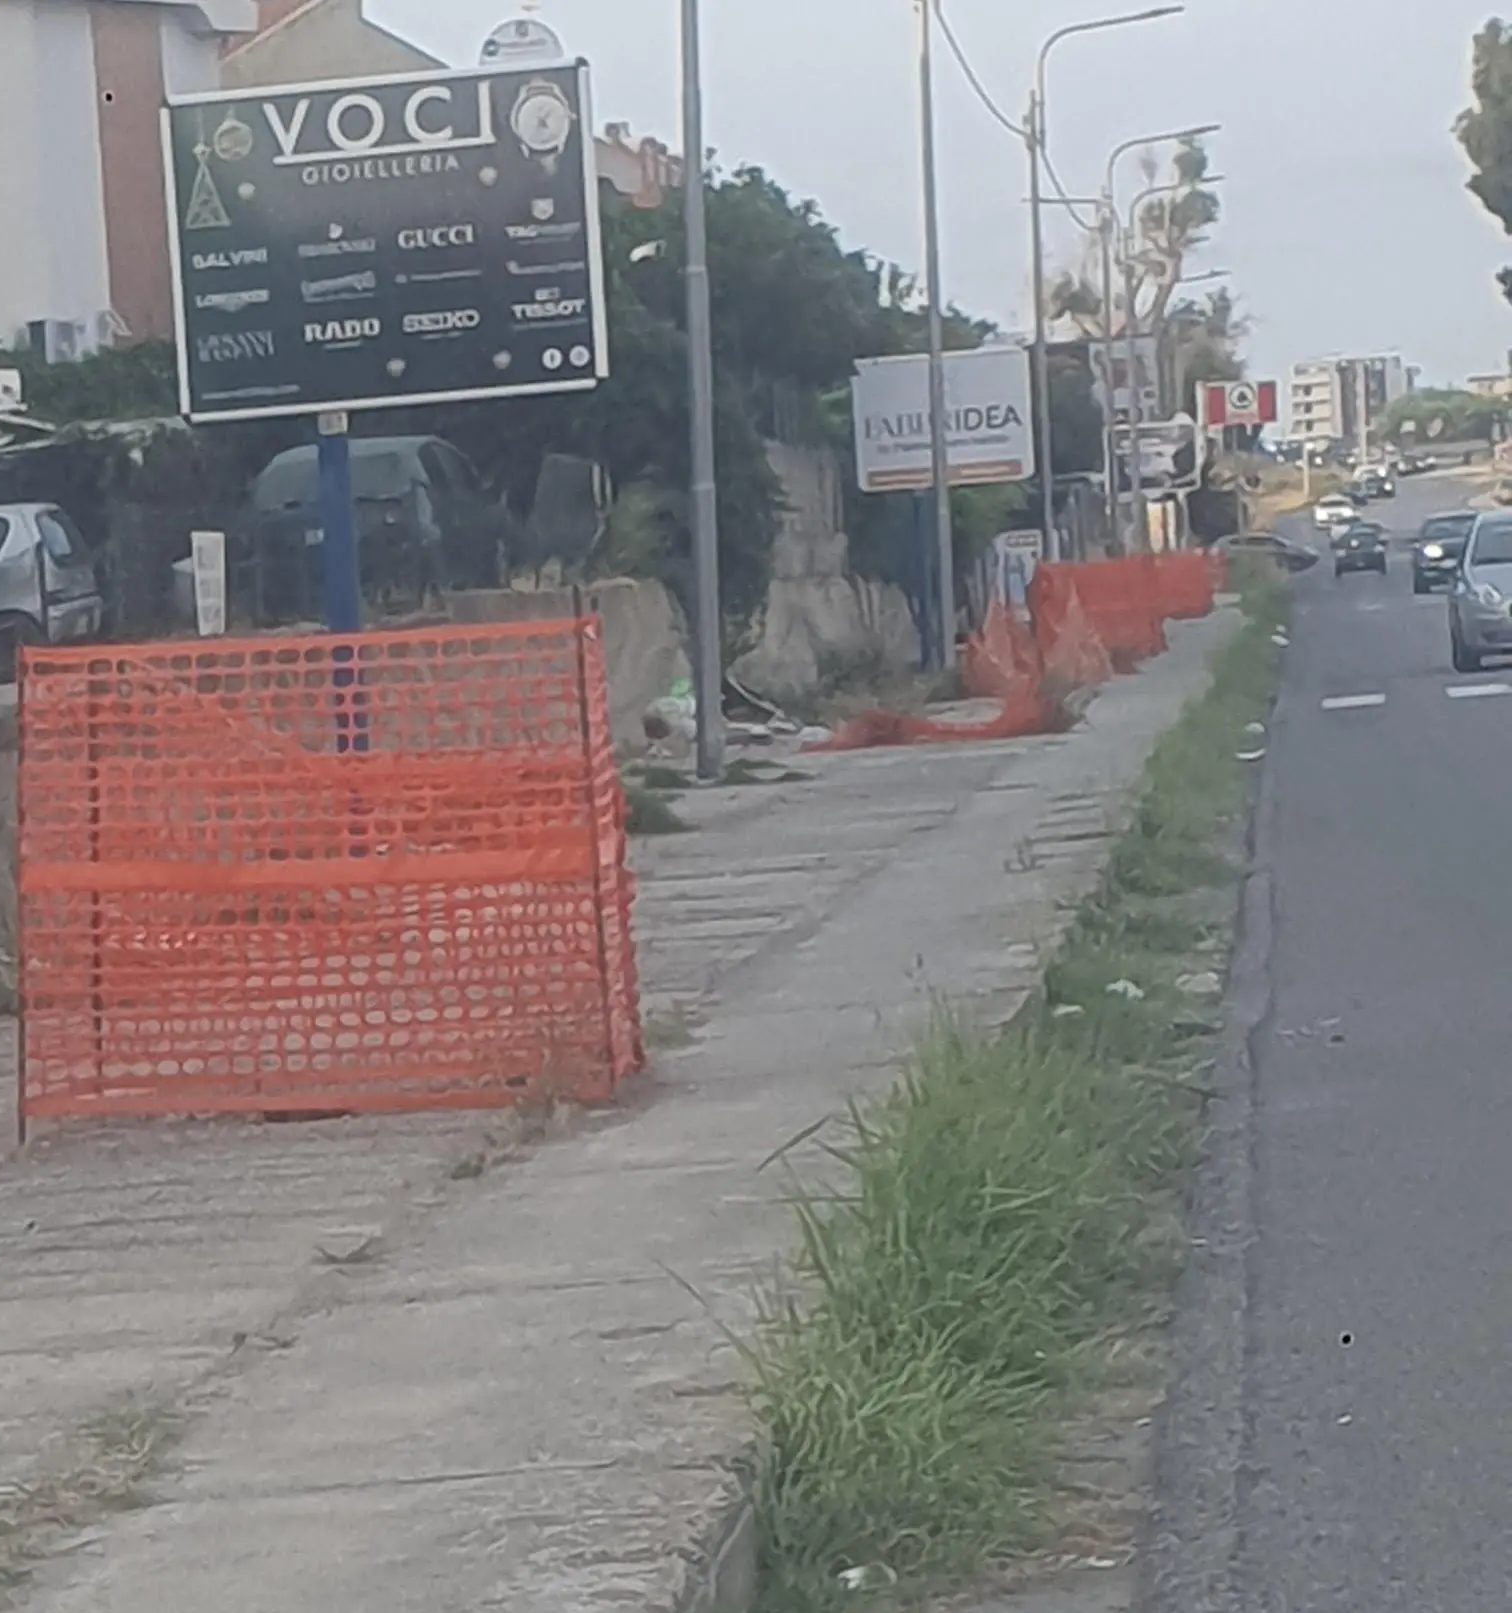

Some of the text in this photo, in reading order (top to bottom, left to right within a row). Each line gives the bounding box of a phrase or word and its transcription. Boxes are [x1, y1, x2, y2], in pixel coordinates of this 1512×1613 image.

[262, 79, 495, 158] VOCI
[301, 155, 461, 186] GIOIELLERIA
[397, 223, 475, 249] GUCCI
[402, 308, 481, 334] SEIKO
[510, 298, 586, 320] TISSOT
[303, 317, 382, 343] RADO
